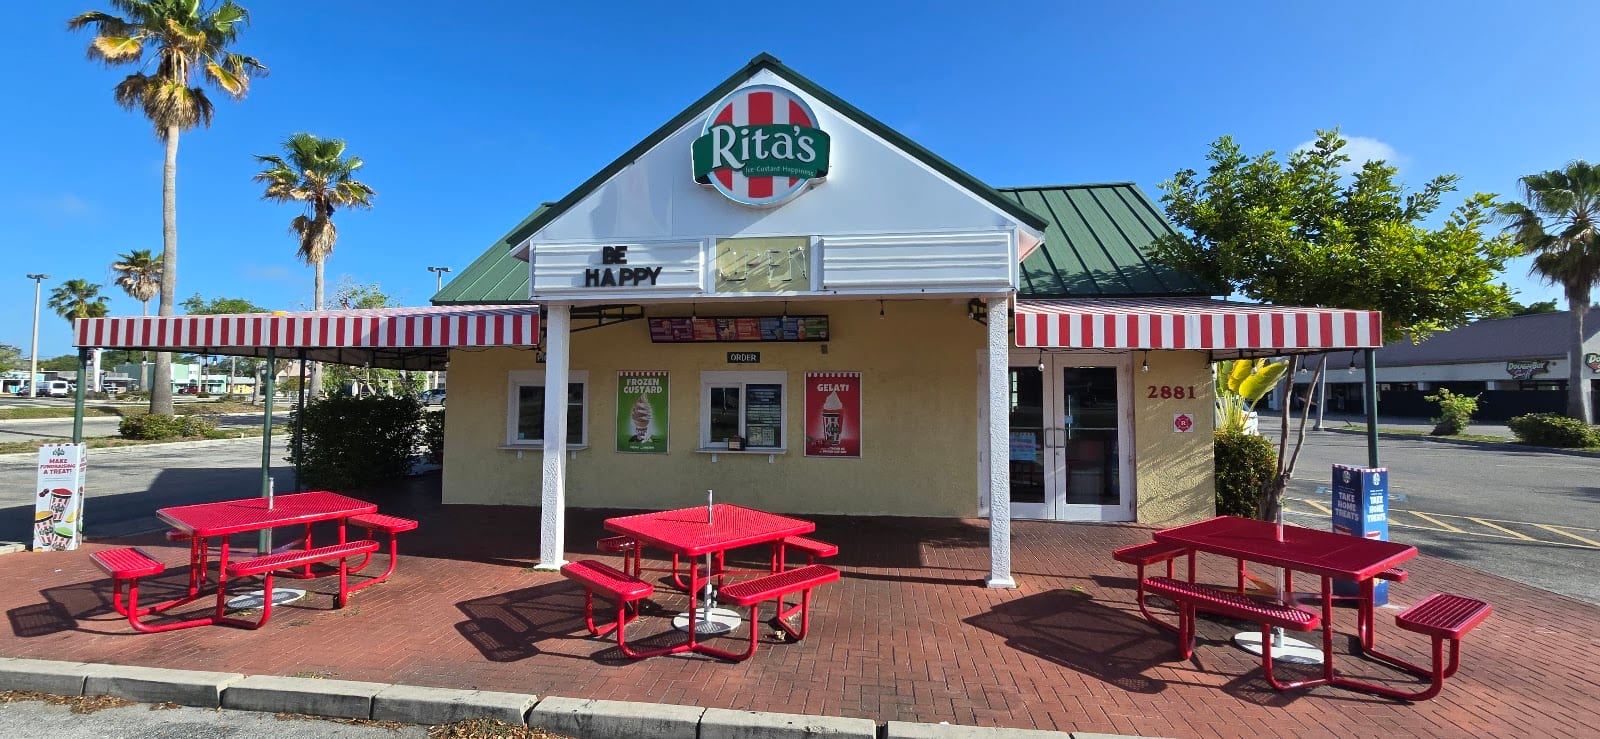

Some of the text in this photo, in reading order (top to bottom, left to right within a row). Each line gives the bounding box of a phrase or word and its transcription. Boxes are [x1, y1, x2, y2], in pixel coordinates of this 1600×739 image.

[712, 125, 816, 169] Rita's
[602, 246, 628, 265] BE
[585, 267, 663, 287] HAPPY
[730, 353, 757, 362] ORDER
[626, 378, 660, 386] FROZEN
[817, 383, 850, 392] GELATI
[623, 386, 663, 394] CUSTARD
[1147, 385, 1197, 399] 2881
[1338, 492, 1356, 502] TAKE
[1337, 500, 1356, 511] HOME
[1336, 508, 1359, 521] TREATS
